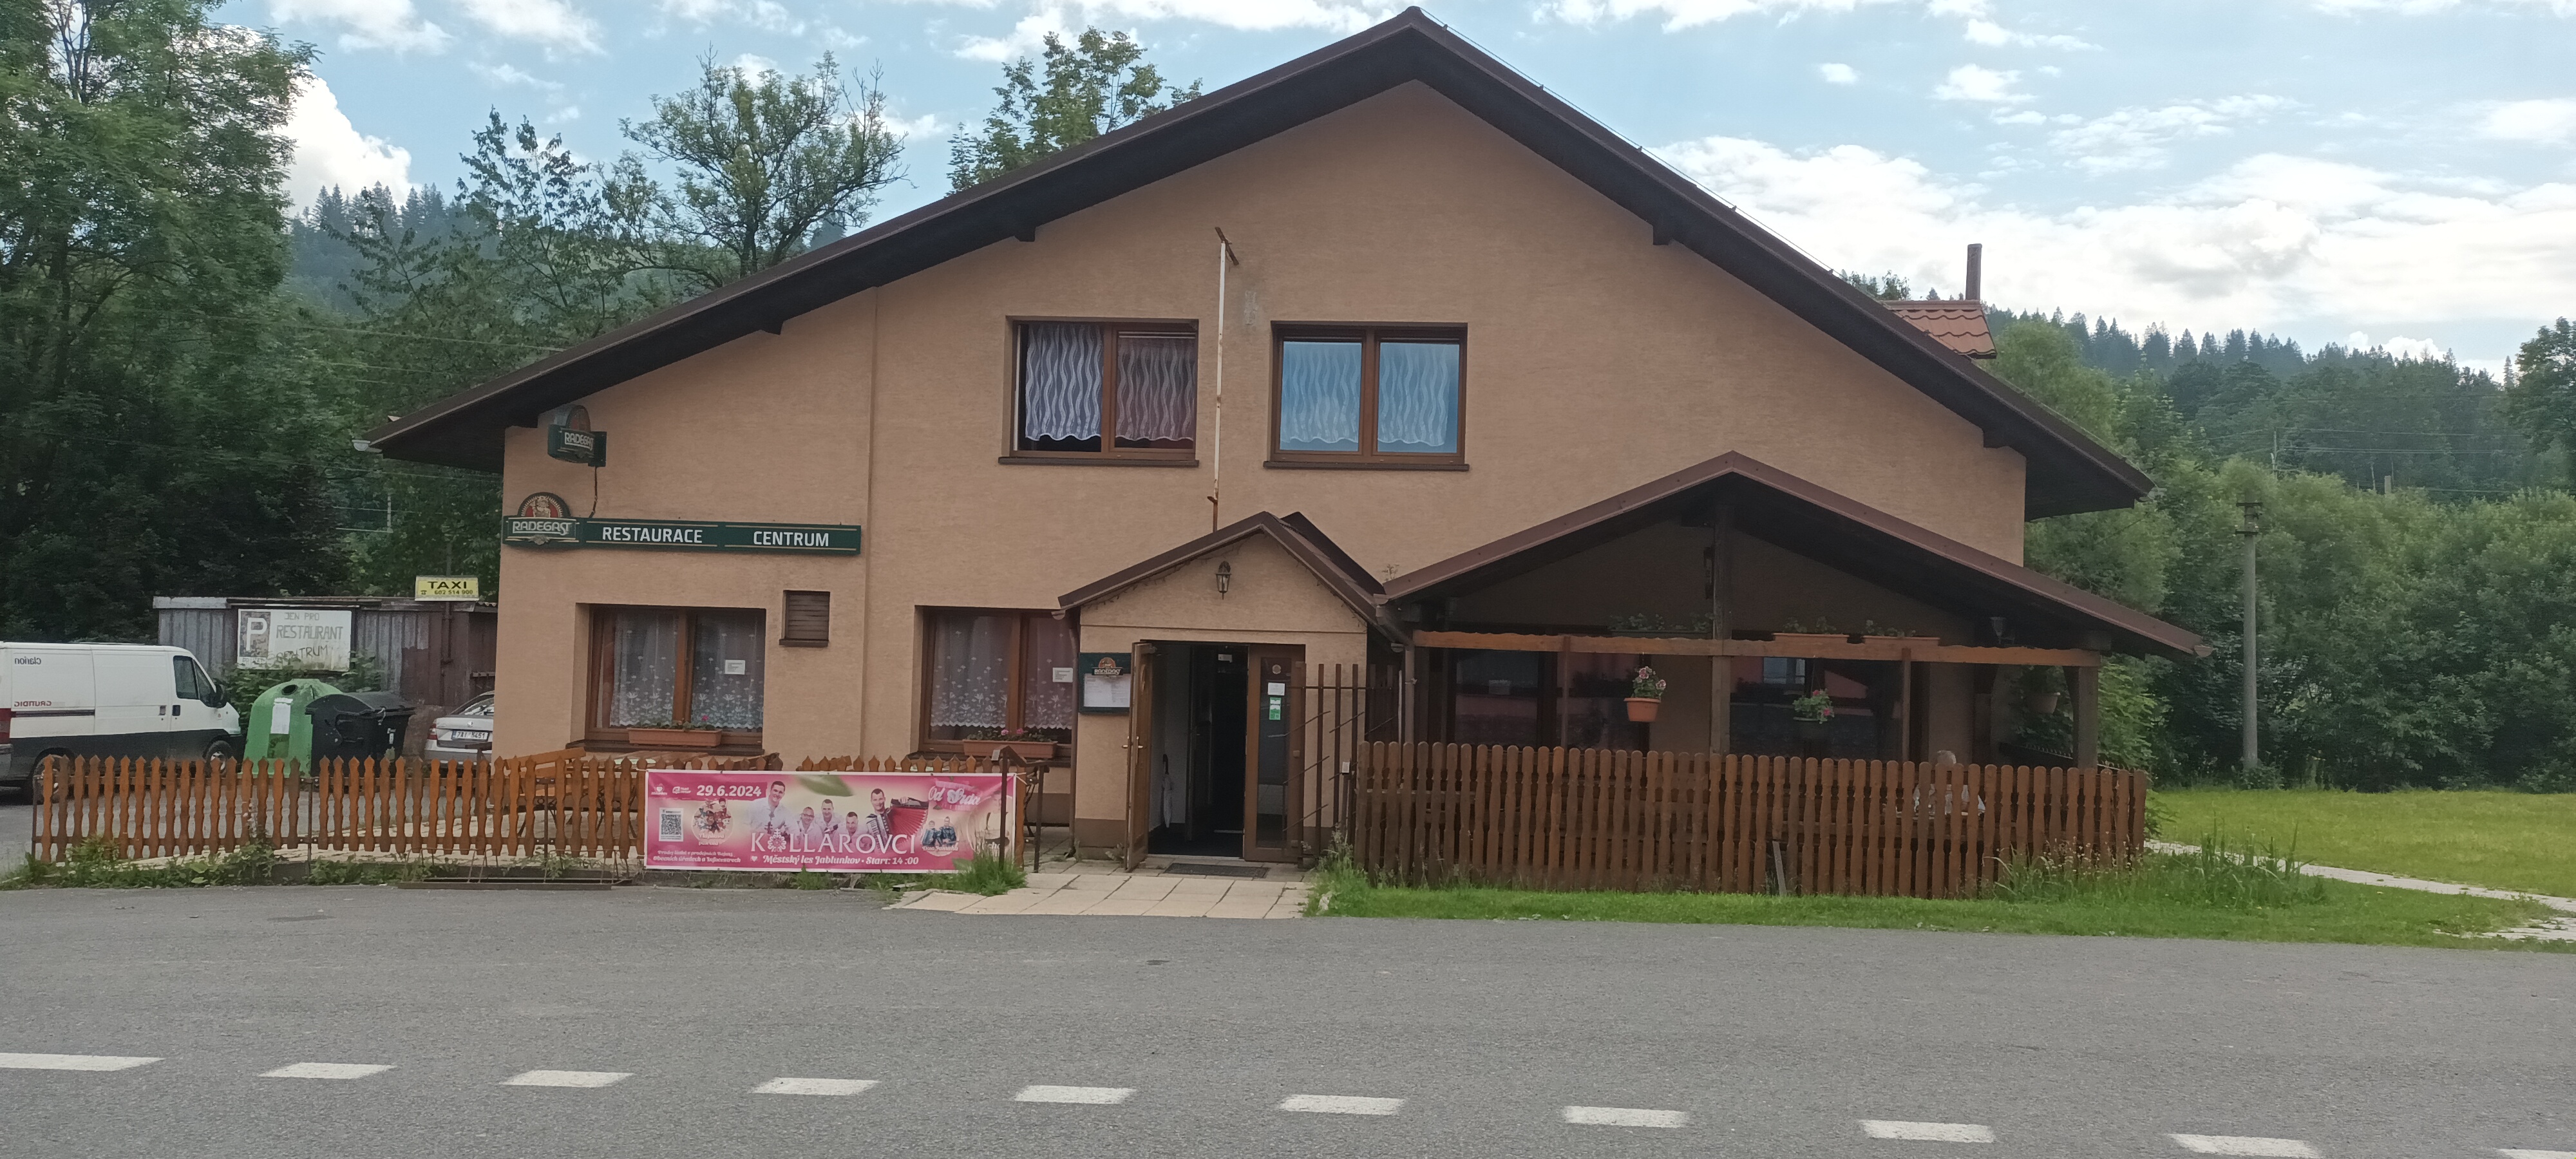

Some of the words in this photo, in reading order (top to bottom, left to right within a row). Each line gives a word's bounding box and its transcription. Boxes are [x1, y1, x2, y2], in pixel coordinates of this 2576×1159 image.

[513, 521, 572, 536] RADEGAST
[602, 527, 703, 543] RESTAURACE
[753, 531, 829, 547] CENTRUM
[427, 581, 467, 589] TAXI
[304, 612, 319, 621] PRO
[246, 617, 268, 652] P
[276, 625, 343, 640] RESTAURANT
[696, 785, 762, 797] 29.6.2024
[928, 786, 945, 802] Od
[762, 854, 800, 865] Městský
[800, 855, 813, 863] les
[815, 855, 861, 865] Jablunkov
